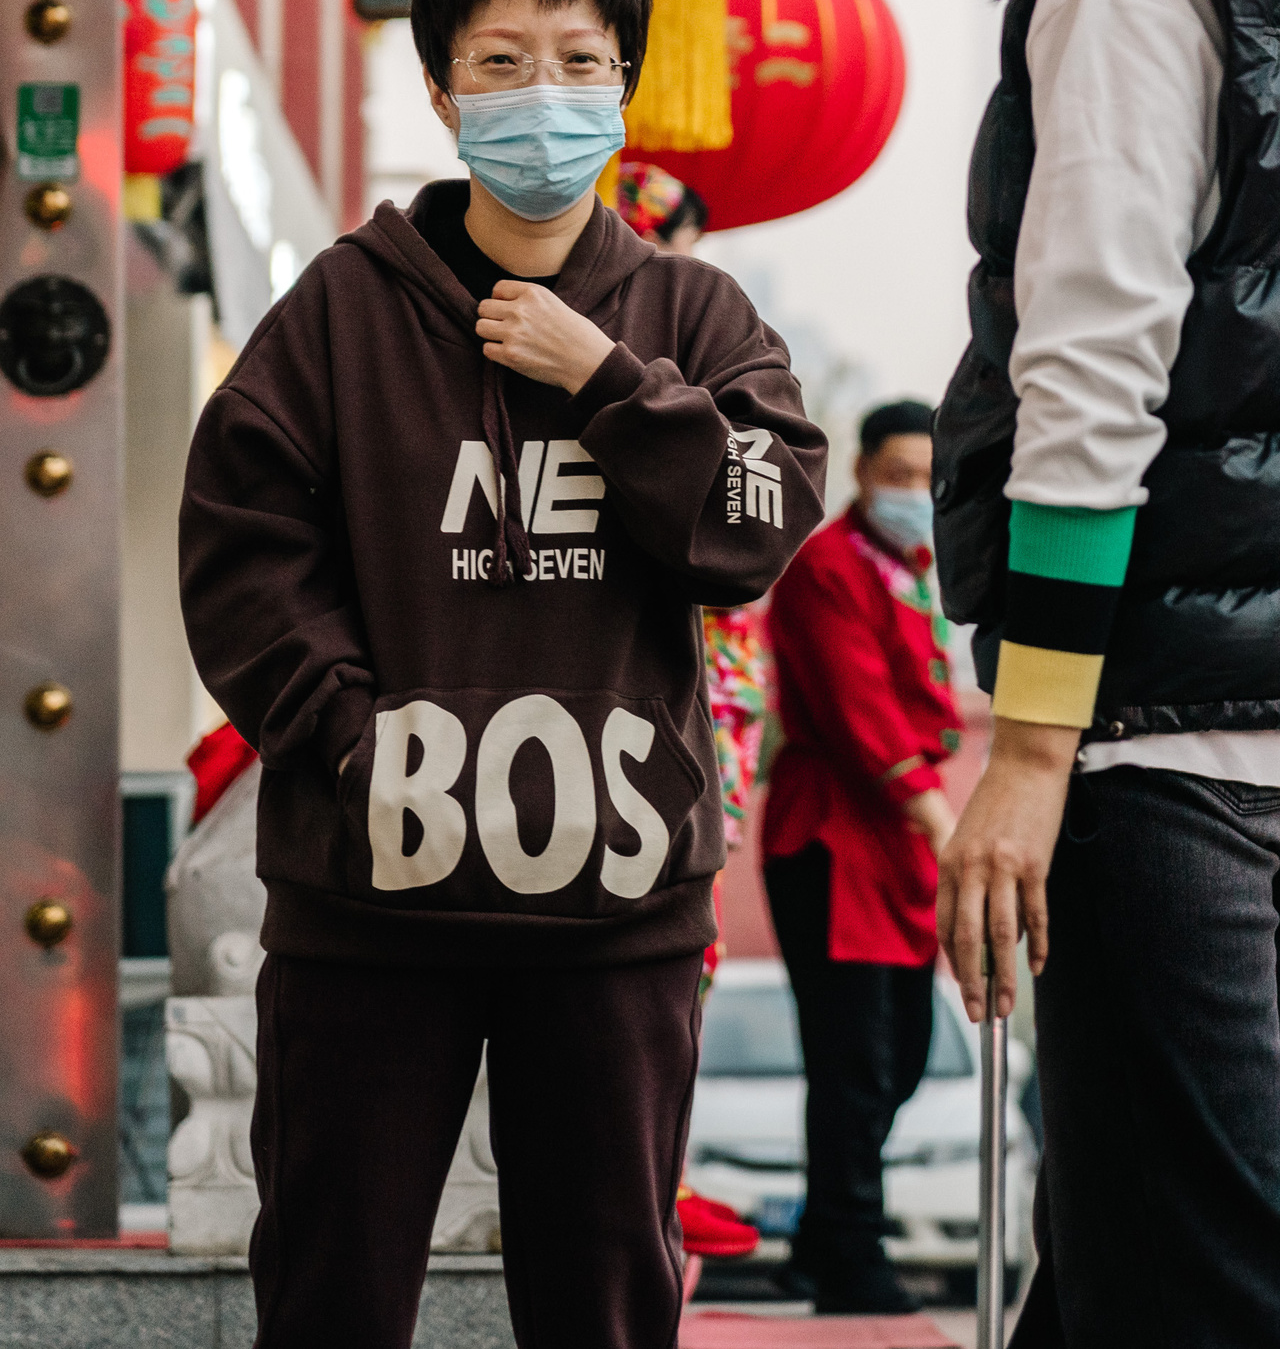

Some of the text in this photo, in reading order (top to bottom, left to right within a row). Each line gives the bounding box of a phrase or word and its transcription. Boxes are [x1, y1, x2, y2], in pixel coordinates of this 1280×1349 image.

[440, 439, 606, 534] NE
[726, 465, 742, 524] SEVEN
[731, 428, 784, 529] NE
[452, 548, 606, 582] HIG SEVEN
[368, 694, 670, 899] BOS
